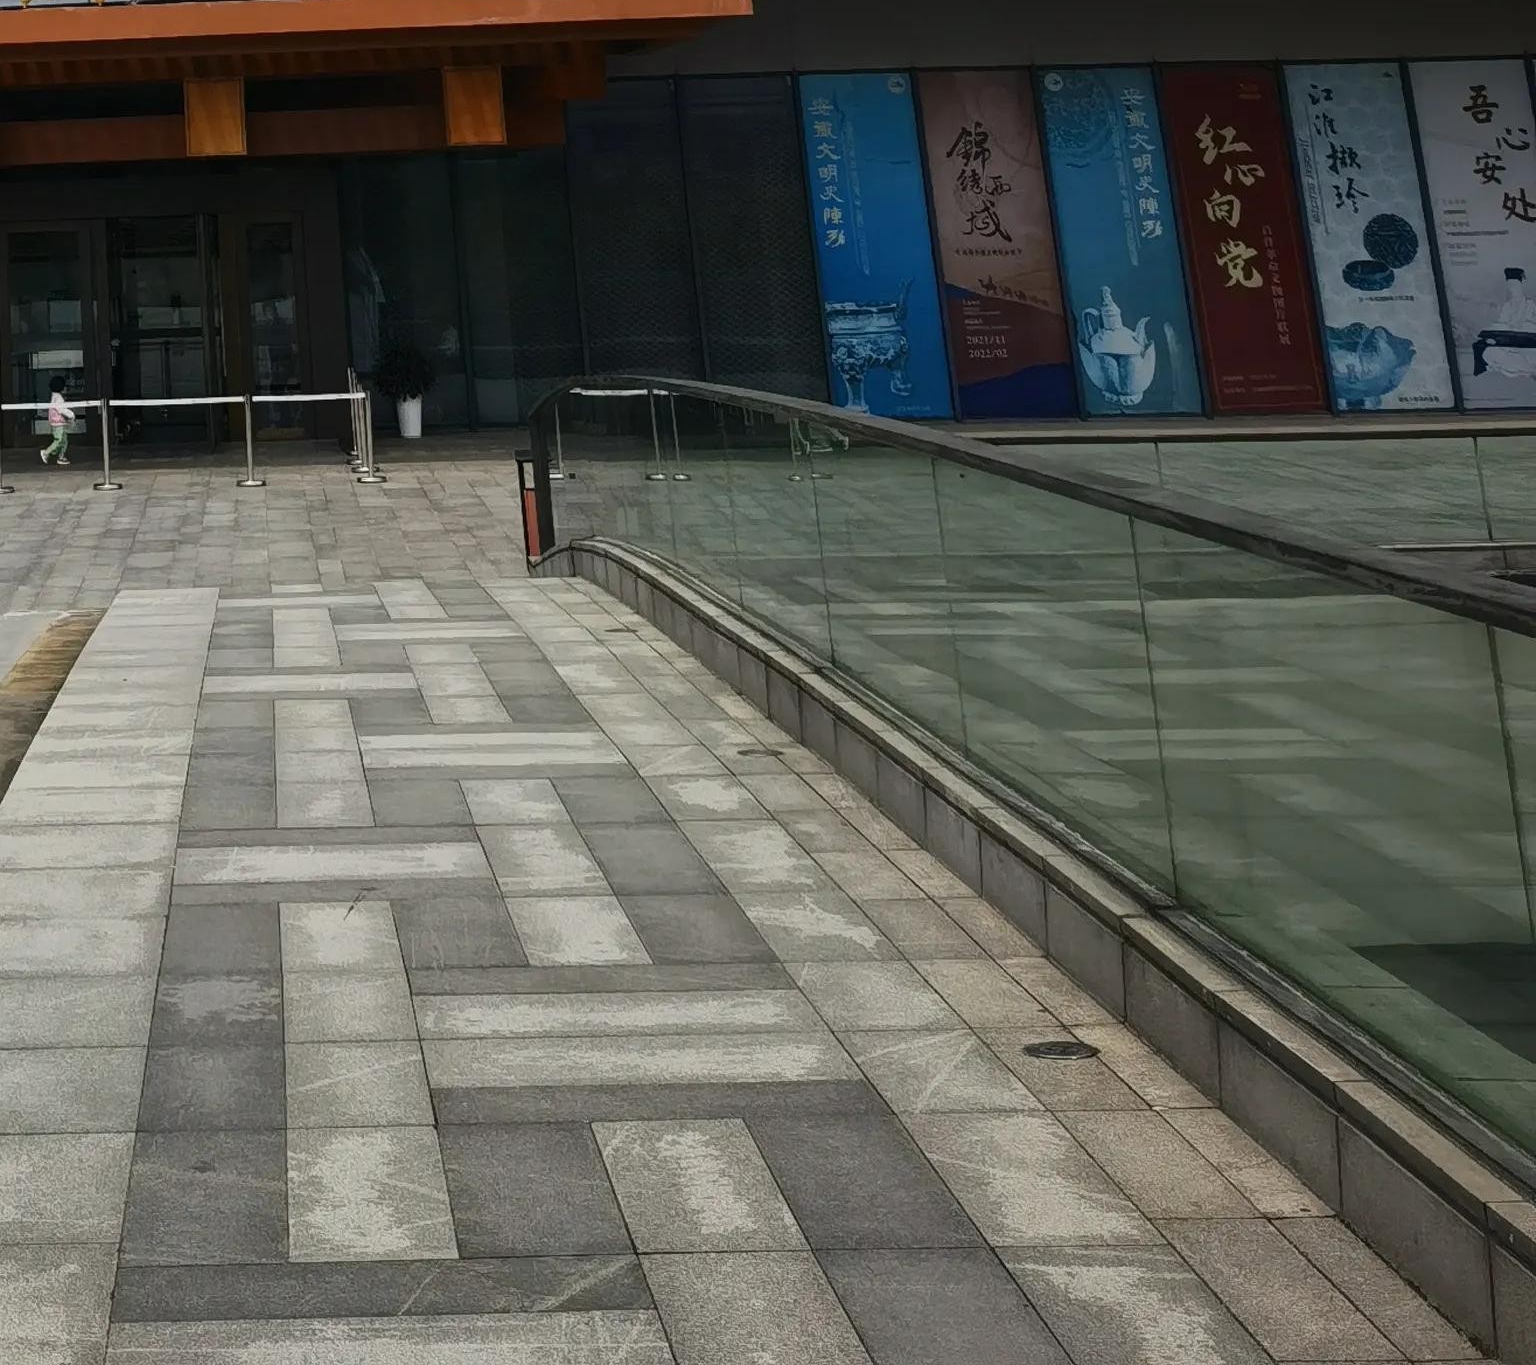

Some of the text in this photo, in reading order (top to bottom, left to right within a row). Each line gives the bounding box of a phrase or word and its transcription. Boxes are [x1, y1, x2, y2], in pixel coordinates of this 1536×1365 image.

[1195, 113, 1266, 289] 红心向党
[1462, 84, 1536, 223] 吾心安处
